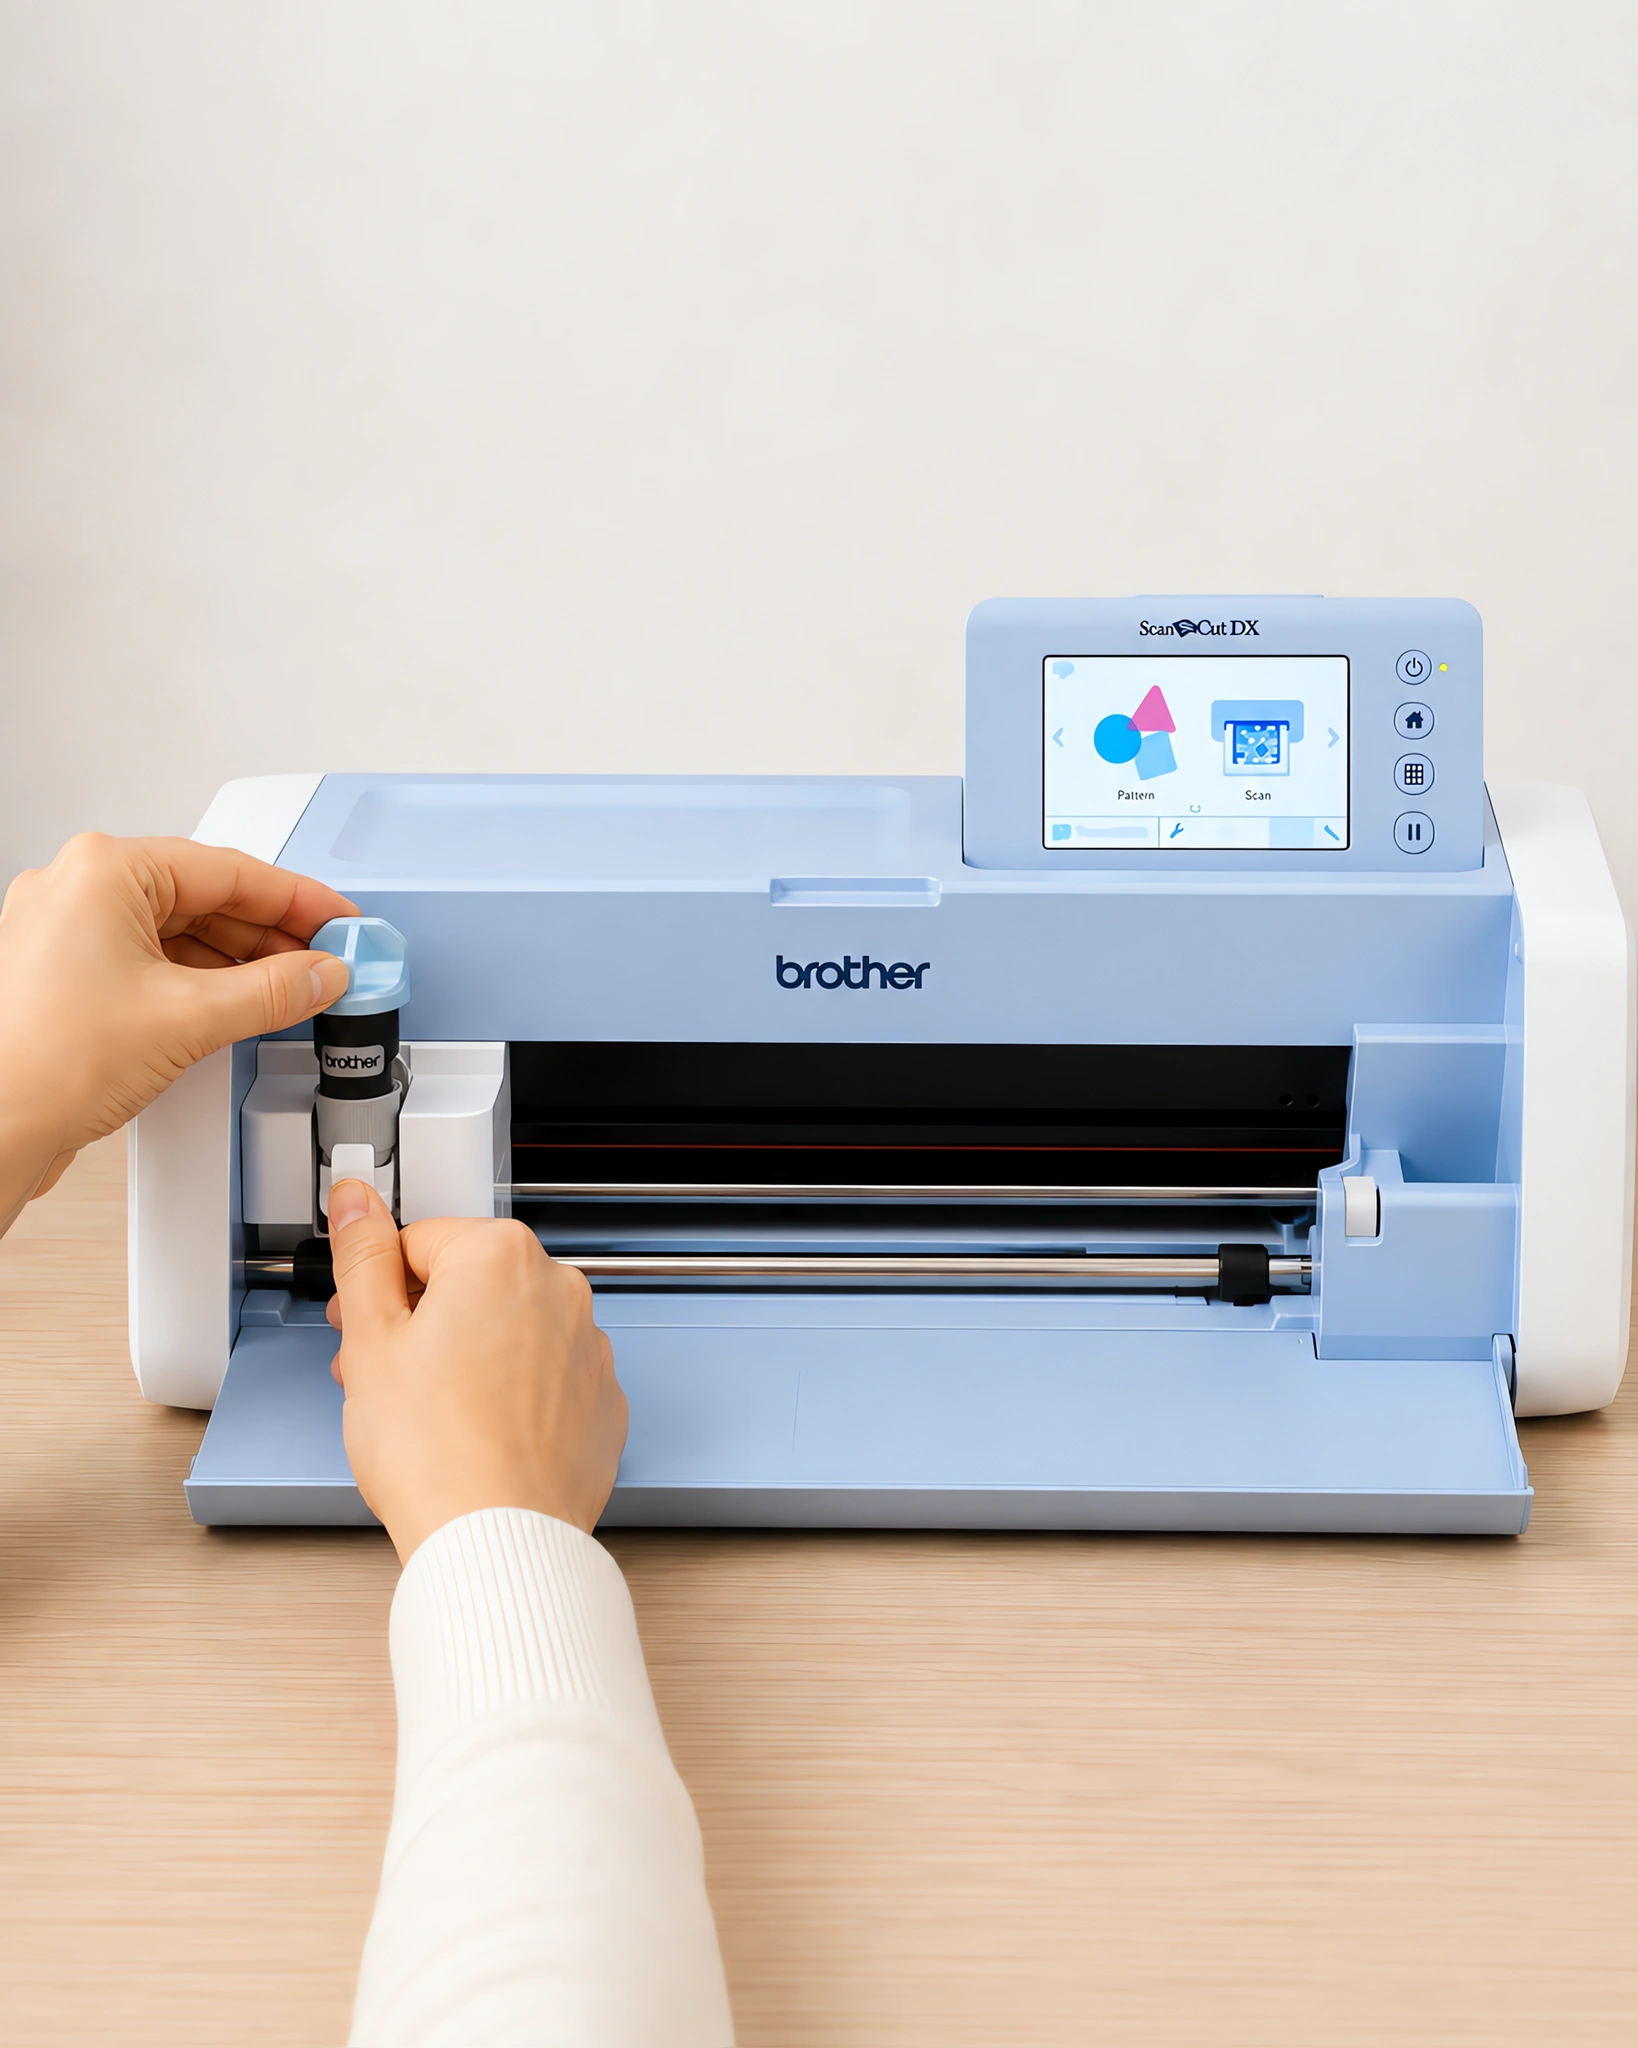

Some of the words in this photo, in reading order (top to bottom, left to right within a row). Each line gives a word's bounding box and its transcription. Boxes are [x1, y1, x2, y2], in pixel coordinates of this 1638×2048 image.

[1229, 620, 1260, 636] DX
[1117, 789, 1155, 801] Pattern
[1245, 789, 1272, 801] Scan
[776, 955, 930, 989] brother
[325, 1052, 381, 1069] brother
